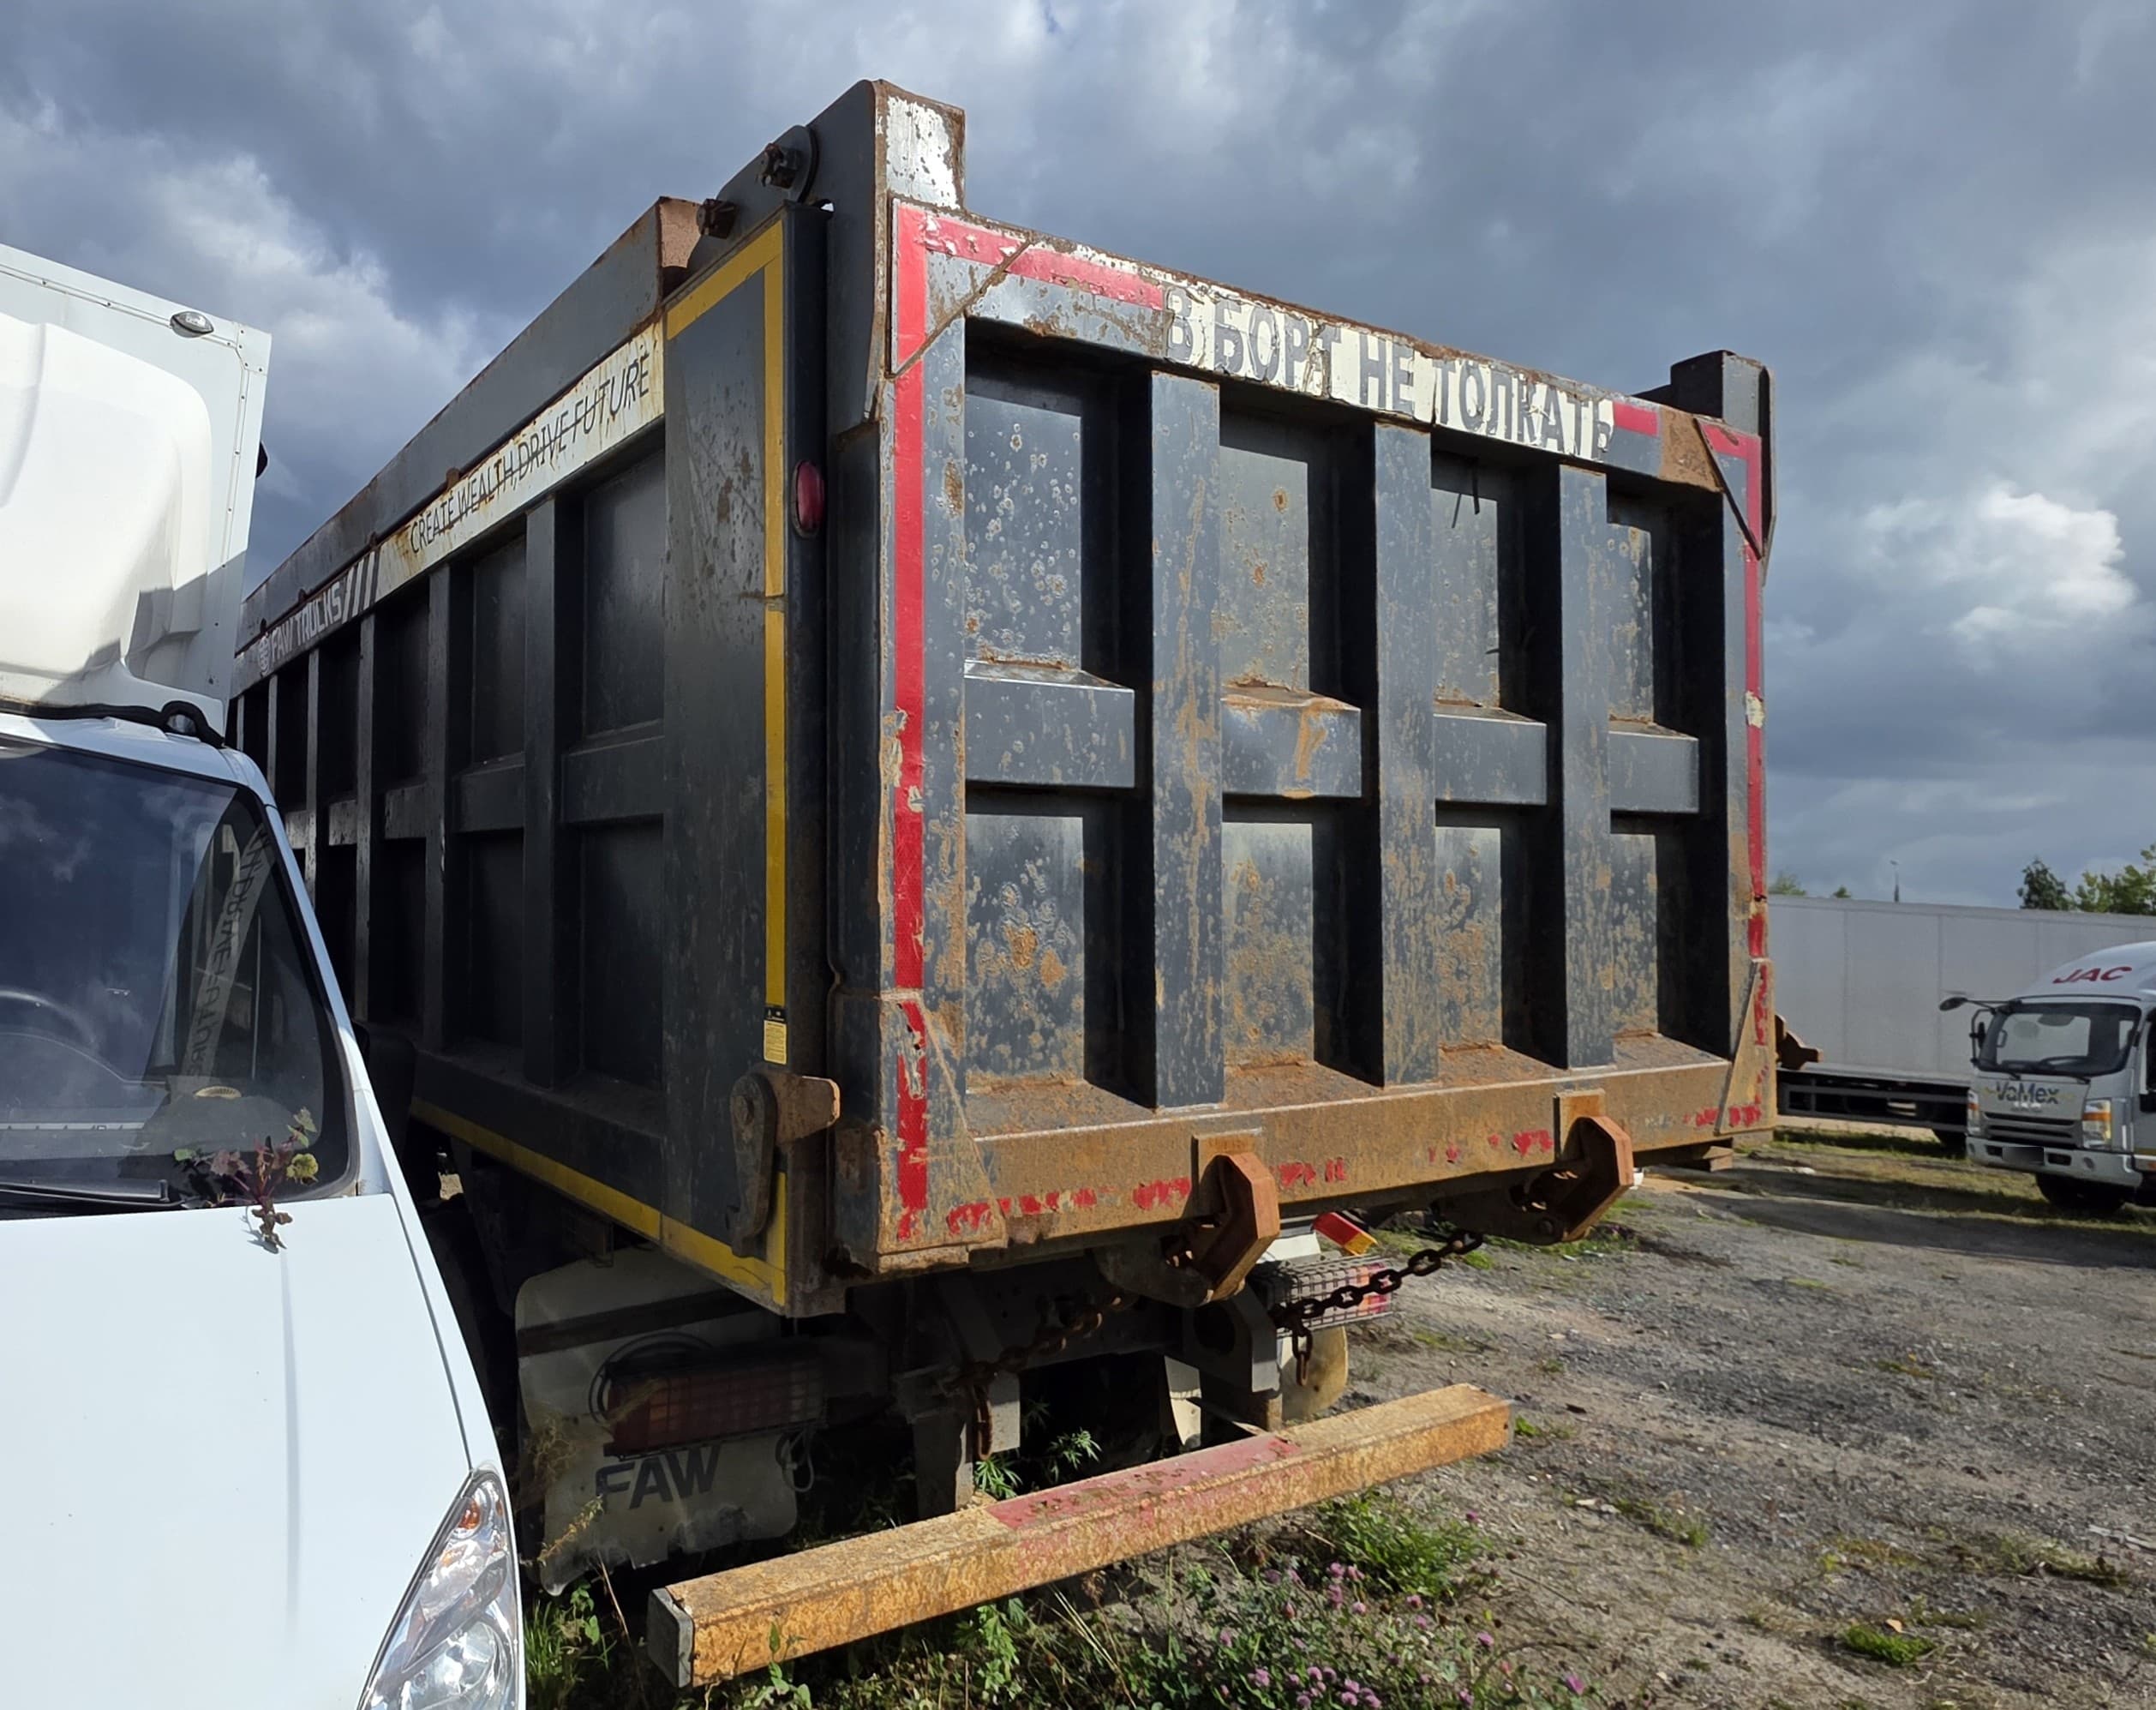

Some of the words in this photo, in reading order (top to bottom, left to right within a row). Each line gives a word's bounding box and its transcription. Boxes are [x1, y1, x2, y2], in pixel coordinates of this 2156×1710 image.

[1165, 287, 1193, 364] В
[1213, 297, 1340, 398] БОРТ
[1359, 333, 1414, 414] НЕ
[1431, 358, 1614, 460] ТОЛКАТЬ
[410, 495, 455, 554] CREATE
[572, 356, 650, 443] FUTURE
[271, 619, 293, 663] FAW
[2052, 966, 2132, 984] JAC
[1996, 1081, 2060, 1105] VaMex
[596, 1444, 721, 1514] FAW
